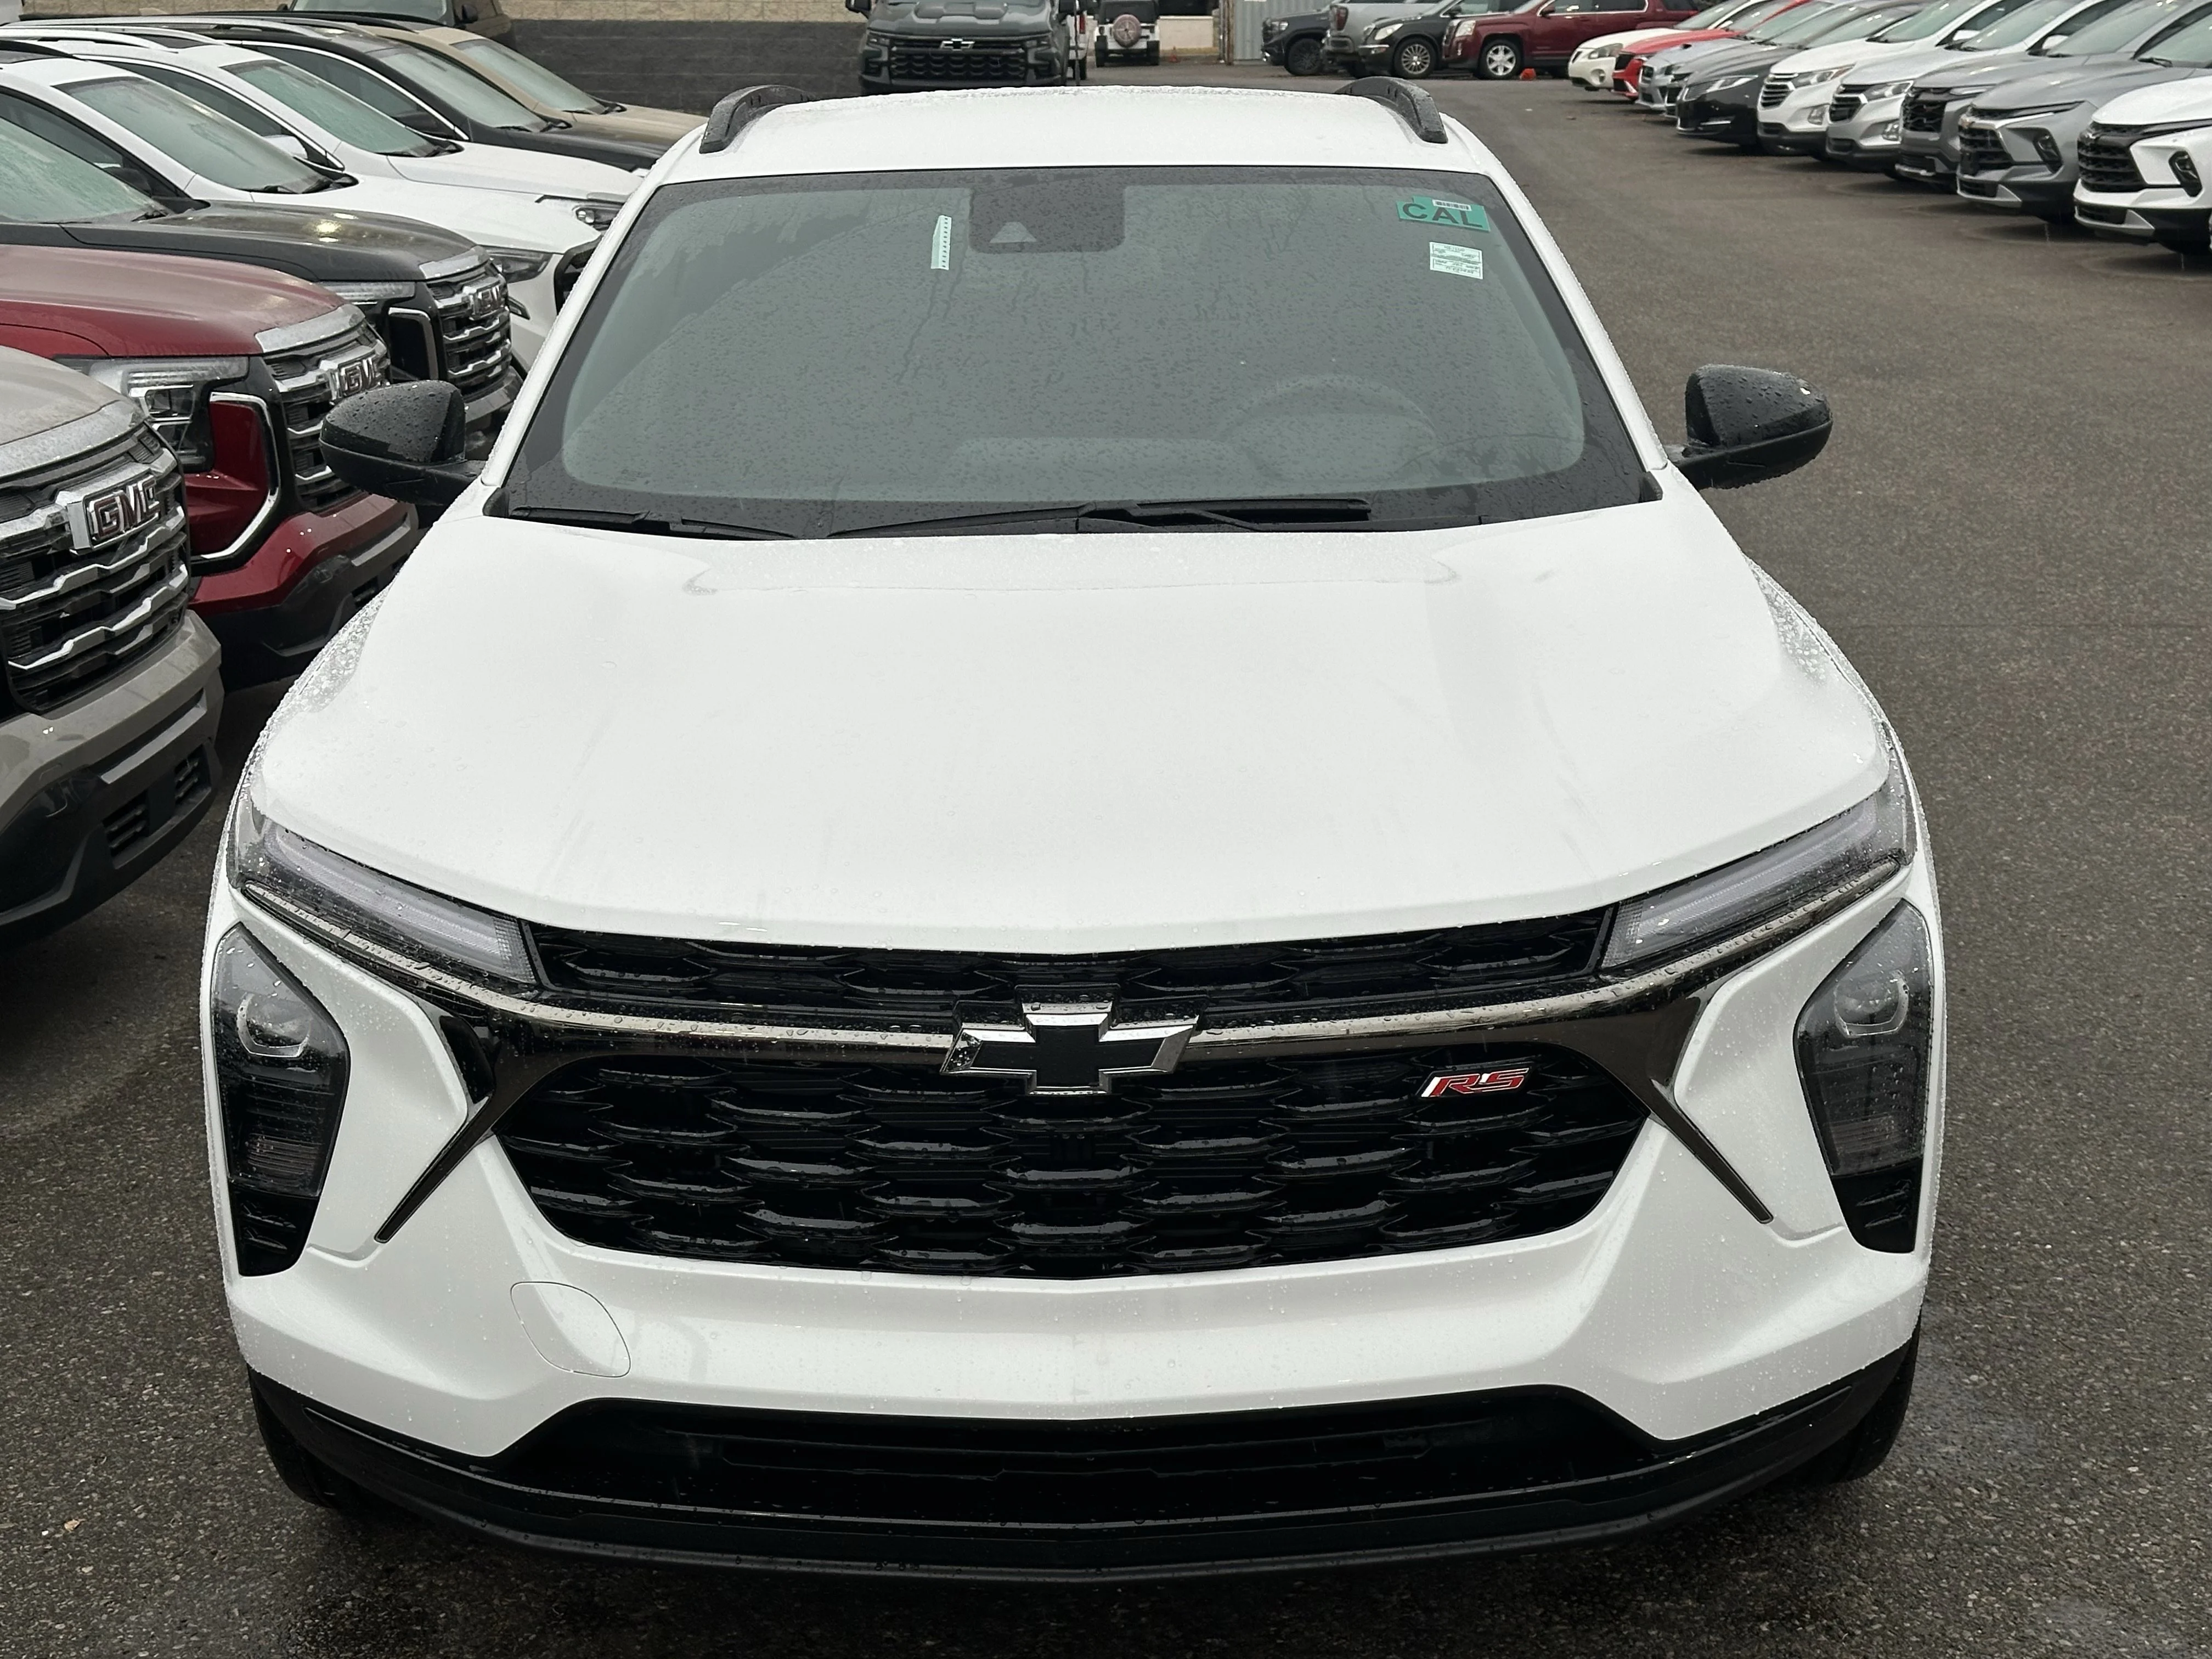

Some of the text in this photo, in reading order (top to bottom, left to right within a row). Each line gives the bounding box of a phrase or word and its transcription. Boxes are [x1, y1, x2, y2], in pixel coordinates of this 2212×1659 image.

[1403, 203, 1483, 228] CAL
[88, 474, 160, 540] GMC
[1421, 1068, 1529, 1097] RS
